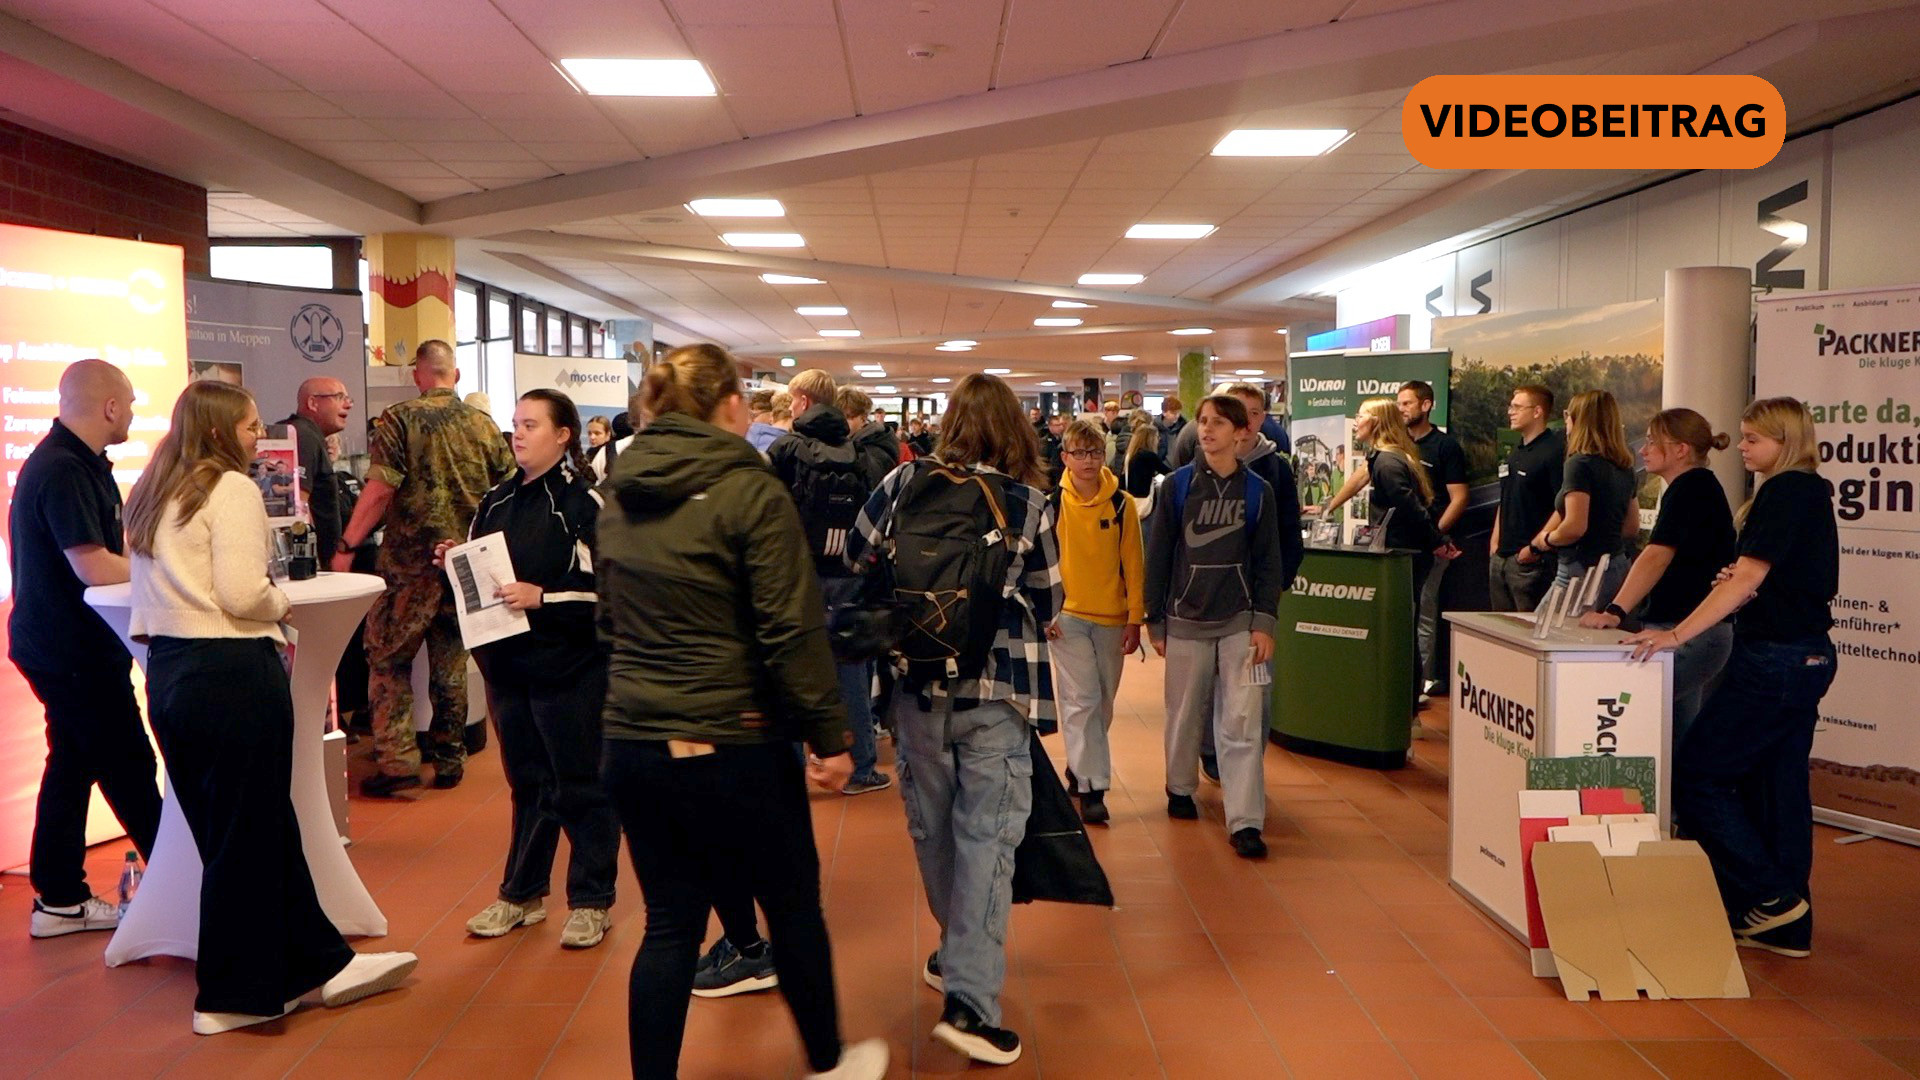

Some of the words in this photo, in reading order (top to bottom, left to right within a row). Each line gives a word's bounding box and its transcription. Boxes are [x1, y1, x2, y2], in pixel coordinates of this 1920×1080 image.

[1794, 304, 1825, 312] Praktikum
[1852, 299, 1889, 308] Ausbildung
[229, 330, 271, 347] Meppen
[1859, 357, 1876, 369] Die
[1879, 356, 1911, 370] kluge
[570, 372, 621, 384] mosecker
[1876, 397, 1920, 428] da,
[1196, 499, 1246, 525] NIKE
[1841, 546, 1854, 555] bei
[1856, 547, 1870, 557] der
[1872, 549, 1903, 560] klugen
[1308, 582, 1377, 601] KRONE
[1878, 599, 1889, 614] &
[1460, 671, 1534, 741] PACKNERS
[1823, 717, 1878, 732] reinschauen!
[1484, 725, 1495, 744] Die
[1496, 731, 1515, 756] kluge
